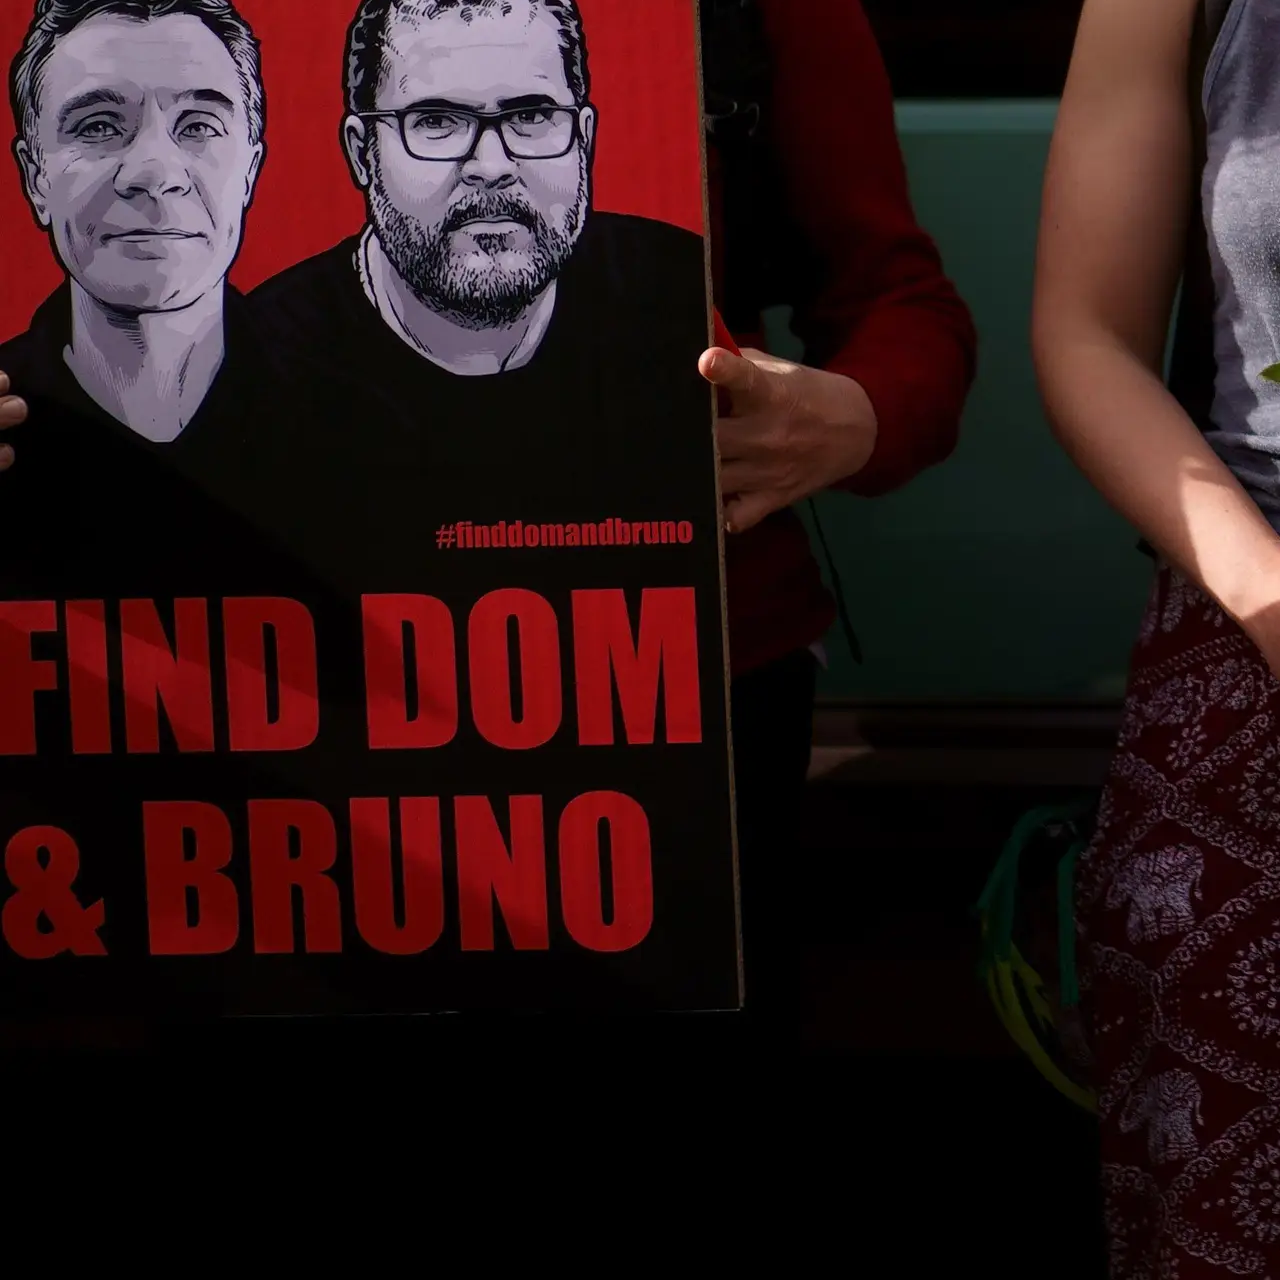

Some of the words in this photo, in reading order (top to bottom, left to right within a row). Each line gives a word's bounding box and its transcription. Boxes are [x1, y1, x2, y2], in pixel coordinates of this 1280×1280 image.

[435, 518, 693, 549] #finddomandbruno
[0, 597, 319, 754] FIND
[361, 587, 702, 750] DOM
[1, 825, 108, 959] &
[142, 790, 654, 955] BRUNO
